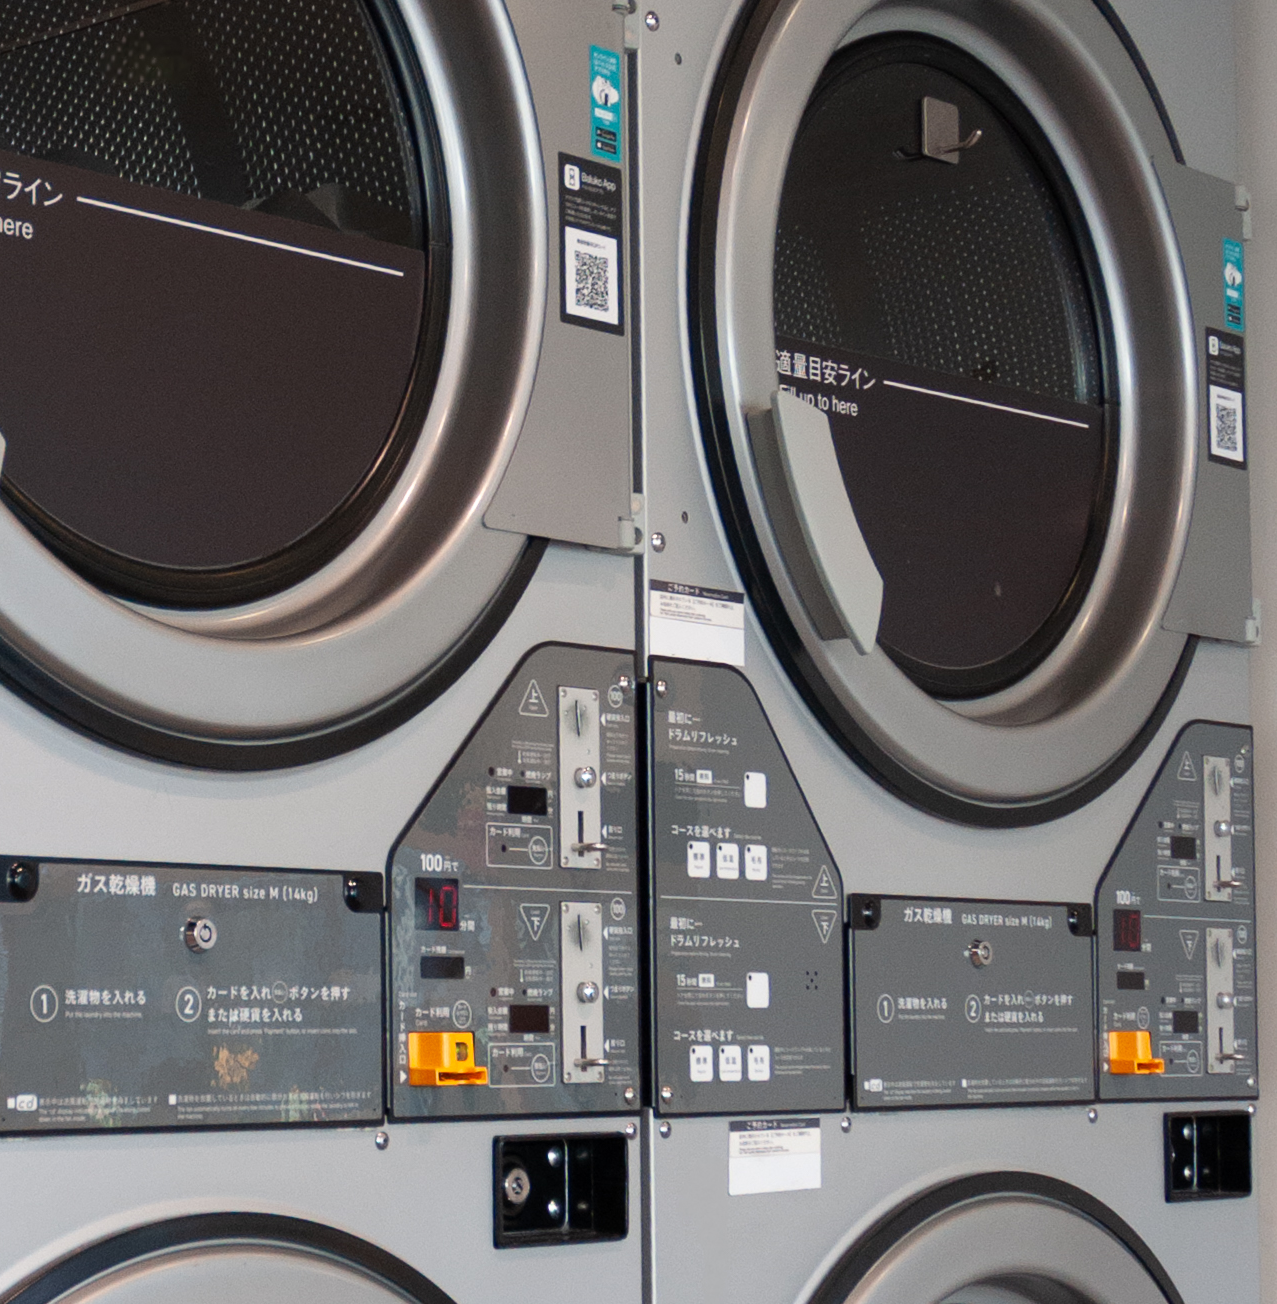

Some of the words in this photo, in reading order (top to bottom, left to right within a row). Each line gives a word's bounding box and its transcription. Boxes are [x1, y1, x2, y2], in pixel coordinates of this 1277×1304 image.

[775, 349, 876, 390] 適量目安ライン
[818, 393, 829, 411] to
[832, 395, 858, 416] here
[529, 688, 539, 703] 上
[668, 729, 737, 746] ドラムリフレッシュ
[671, 824, 732, 839] コースを選べます
[76, 873, 157, 896] ガス乾燥機
[820, 874, 829, 887] 上
[172, 882, 197, 897] GAS
[201, 884, 239, 899] DRYER
[243, 886, 266, 900] size
[269, 886, 279, 900] M
[282, 886, 319, 904] (14kg)
[428, 885, 457, 928] 10
[531, 916, 541, 931] 下
[903, 907, 953, 925] ガス乾燥機
[961, 913, 977, 925] GAS
[978, 914, 1003, 926] DRYER
[1005, 915, 1020, 927] size
[821, 921, 829, 935] 下
[670, 934, 740, 948] ドラムリフレッシュ
[64, 988, 147, 1005] 洗濯物を入れる
[207, 986, 272, 1001] カードを入れ
[289, 986, 351, 1001] ボタンを押す
[40, 993, 48, 1014] 1
[183, 993, 194, 1015] 2
[969, 1000, 977, 1017] 2
[207, 1008, 303, 1023] または硬貨を入れる
[415, 1006, 450, 1019] カード利用
[673, 1029, 734, 1042] コースを選べます
